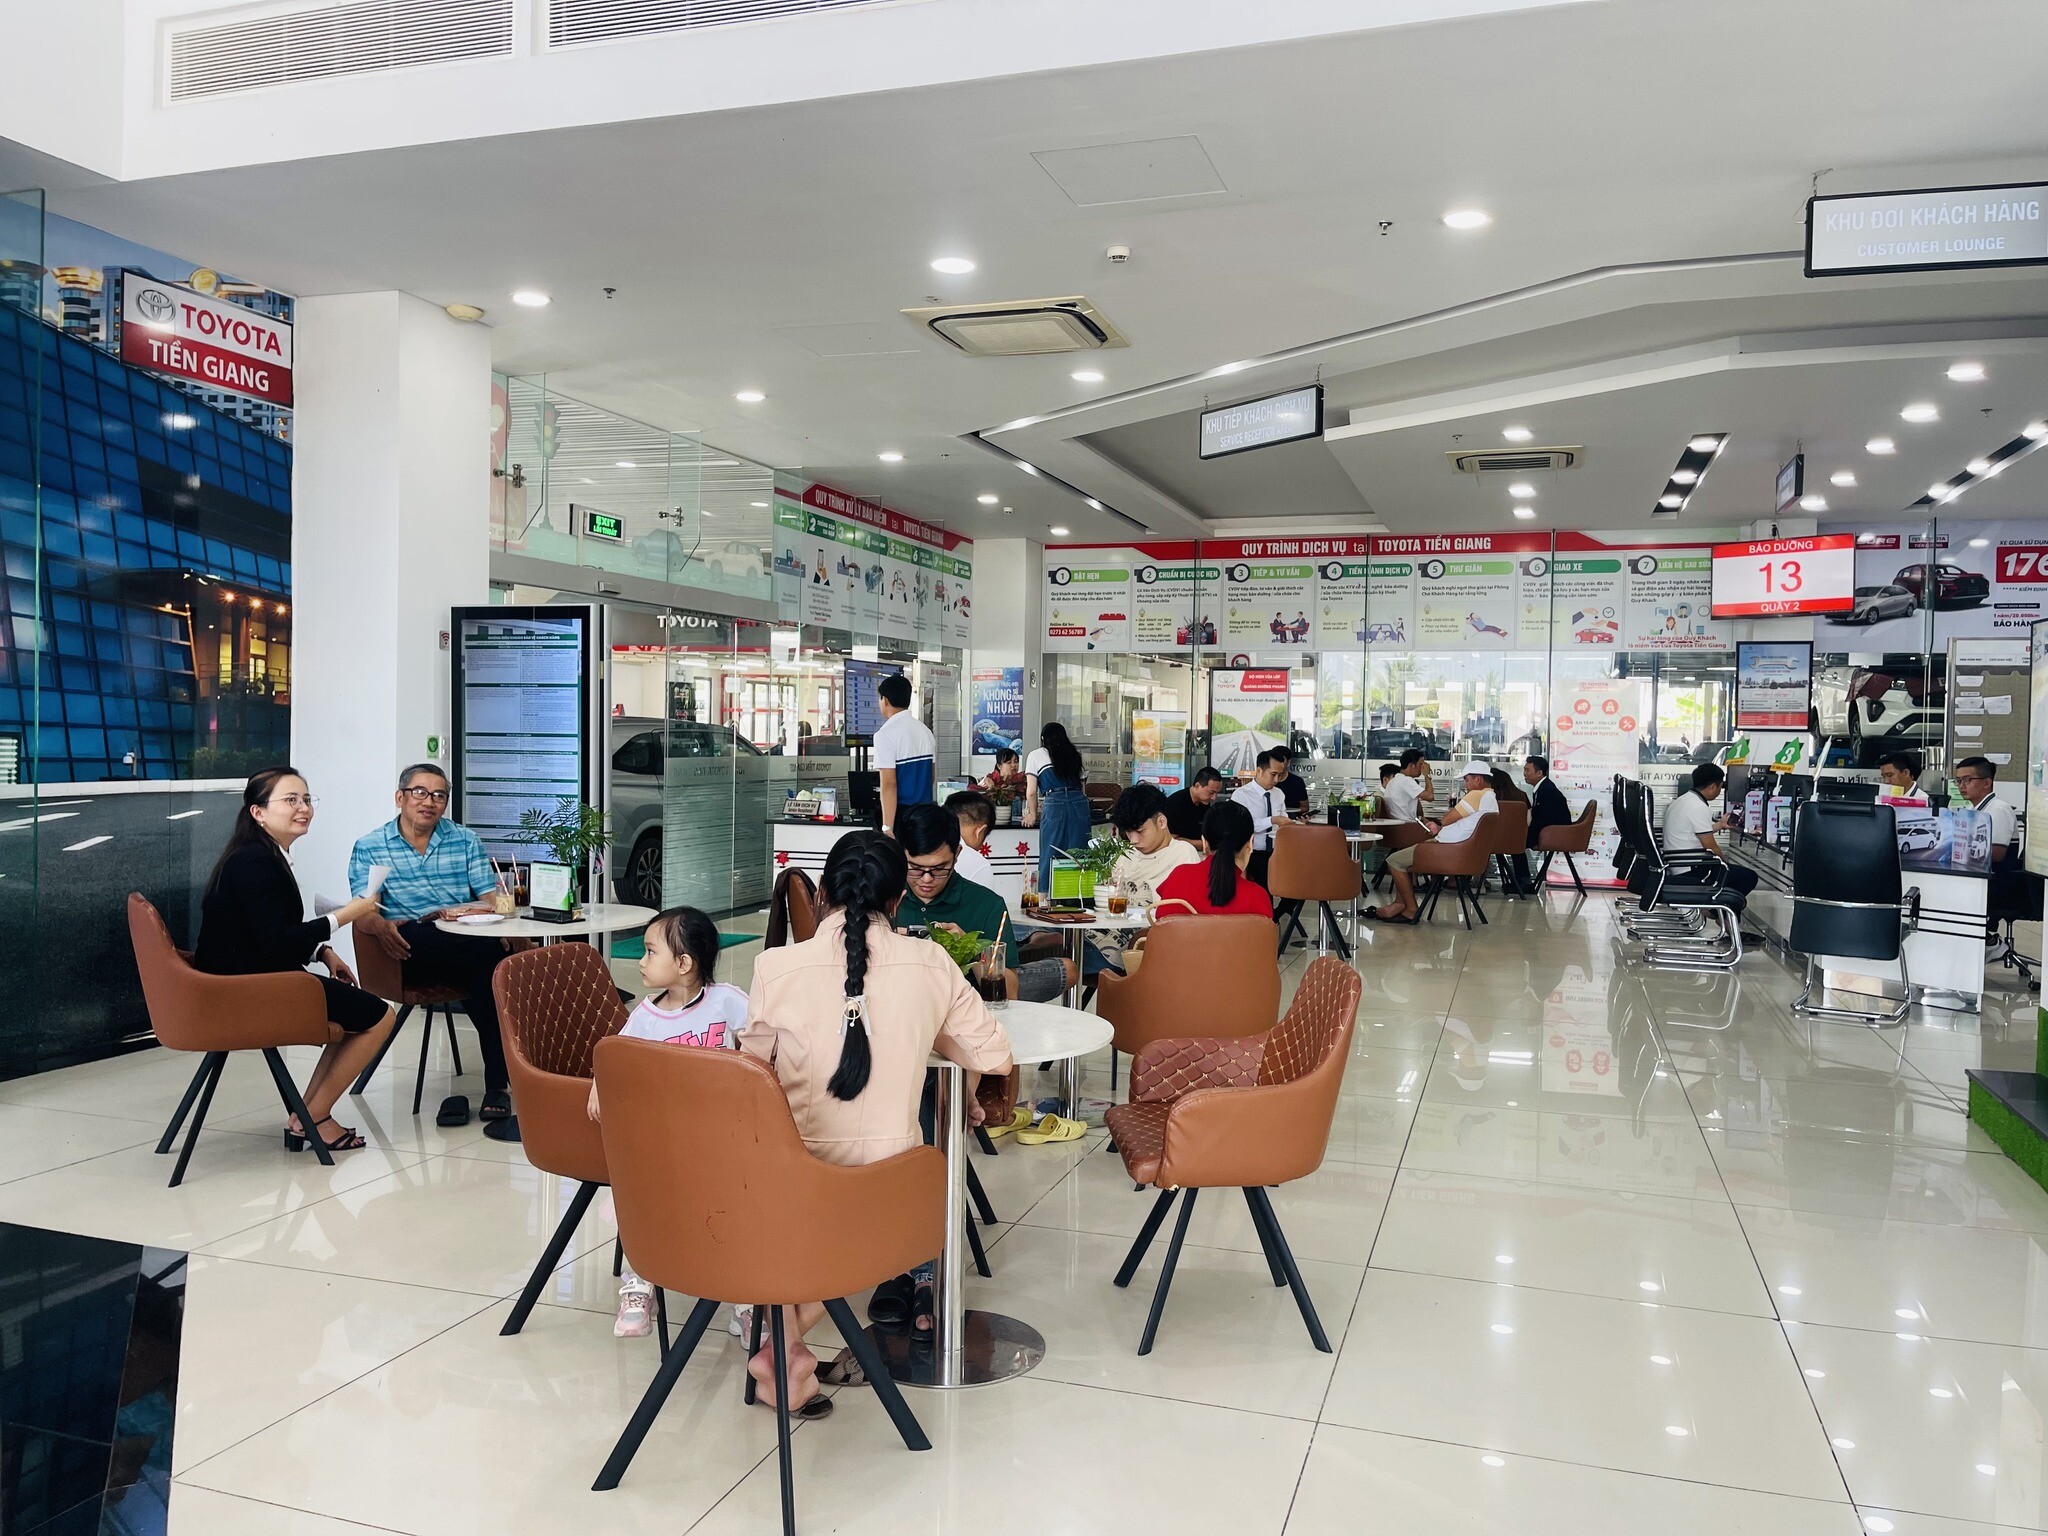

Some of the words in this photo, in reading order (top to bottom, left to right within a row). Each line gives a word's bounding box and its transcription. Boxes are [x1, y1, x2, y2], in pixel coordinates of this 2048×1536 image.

[1826, 212, 1864, 232] KHU
[1871, 208, 1903, 232] ĐỢI
[1911, 202, 1977, 227] KHÁCH
[1984, 199, 2040, 222] HÀNG
[1858, 241, 1939, 257] CUSTOMER
[1945, 237, 2005, 252] LOUNGE
[181, 303, 282, 356] TOYOTA
[149, 339, 197, 372] TIỀN
[203, 356, 269, 392] GIANG
[1206, 418, 1222, 434] KHU
[1225, 408, 1241, 429] TIẾP
[1244, 404, 1273, 426] KHÁCH
[1221, 432, 1243, 447] SERVICE
[1244, 426, 1275, 442] RECEPTION
[815, 489, 827, 505] QUY
[828, 493, 845, 511] TRÌNH
[904, 520, 920, 536] TOYOTA
[596, 516, 615, 527] EXIT
[809, 518, 816, 531] 2
[838, 527, 844, 539] 3
[866, 535, 871, 547] 4
[1242, 543, 1263, 556] QUY
[1266, 540, 1299, 555] TRÌNH
[1302, 541, 1328, 555] DỊCH
[1332, 540, 1346, 555] VỤ
[1378, 538, 1421, 552] TOYOTA
[1424, 535, 1450, 551] TIỀN
[1454, 537, 1491, 550] GIANG
[1749, 543, 1770, 553] BẢO
[1774, 540, 1813, 551] DƯỠNG
[890, 542, 895, 555] 5
[913, 550, 918, 562] 6
[934, 557, 938, 567] 7
[955, 563, 958, 574] 8
[1554, 563, 1570, 571] GIAO
[1644, 561, 1649, 569] 7
[1759, 561, 1802, 593] 13
[1761, 600, 1790, 612] QUẦY
[1794, 602, 1799, 611] 2
[657, 615, 718, 628] TOYOTA
[1994, 619, 2012, 627] BẢO
[984, 687, 1012, 700] KHÔNG
[987, 701, 1014, 715] NHỰA
[1734, 744, 1742, 758] 1
[1781, 747, 1795, 764] 3
